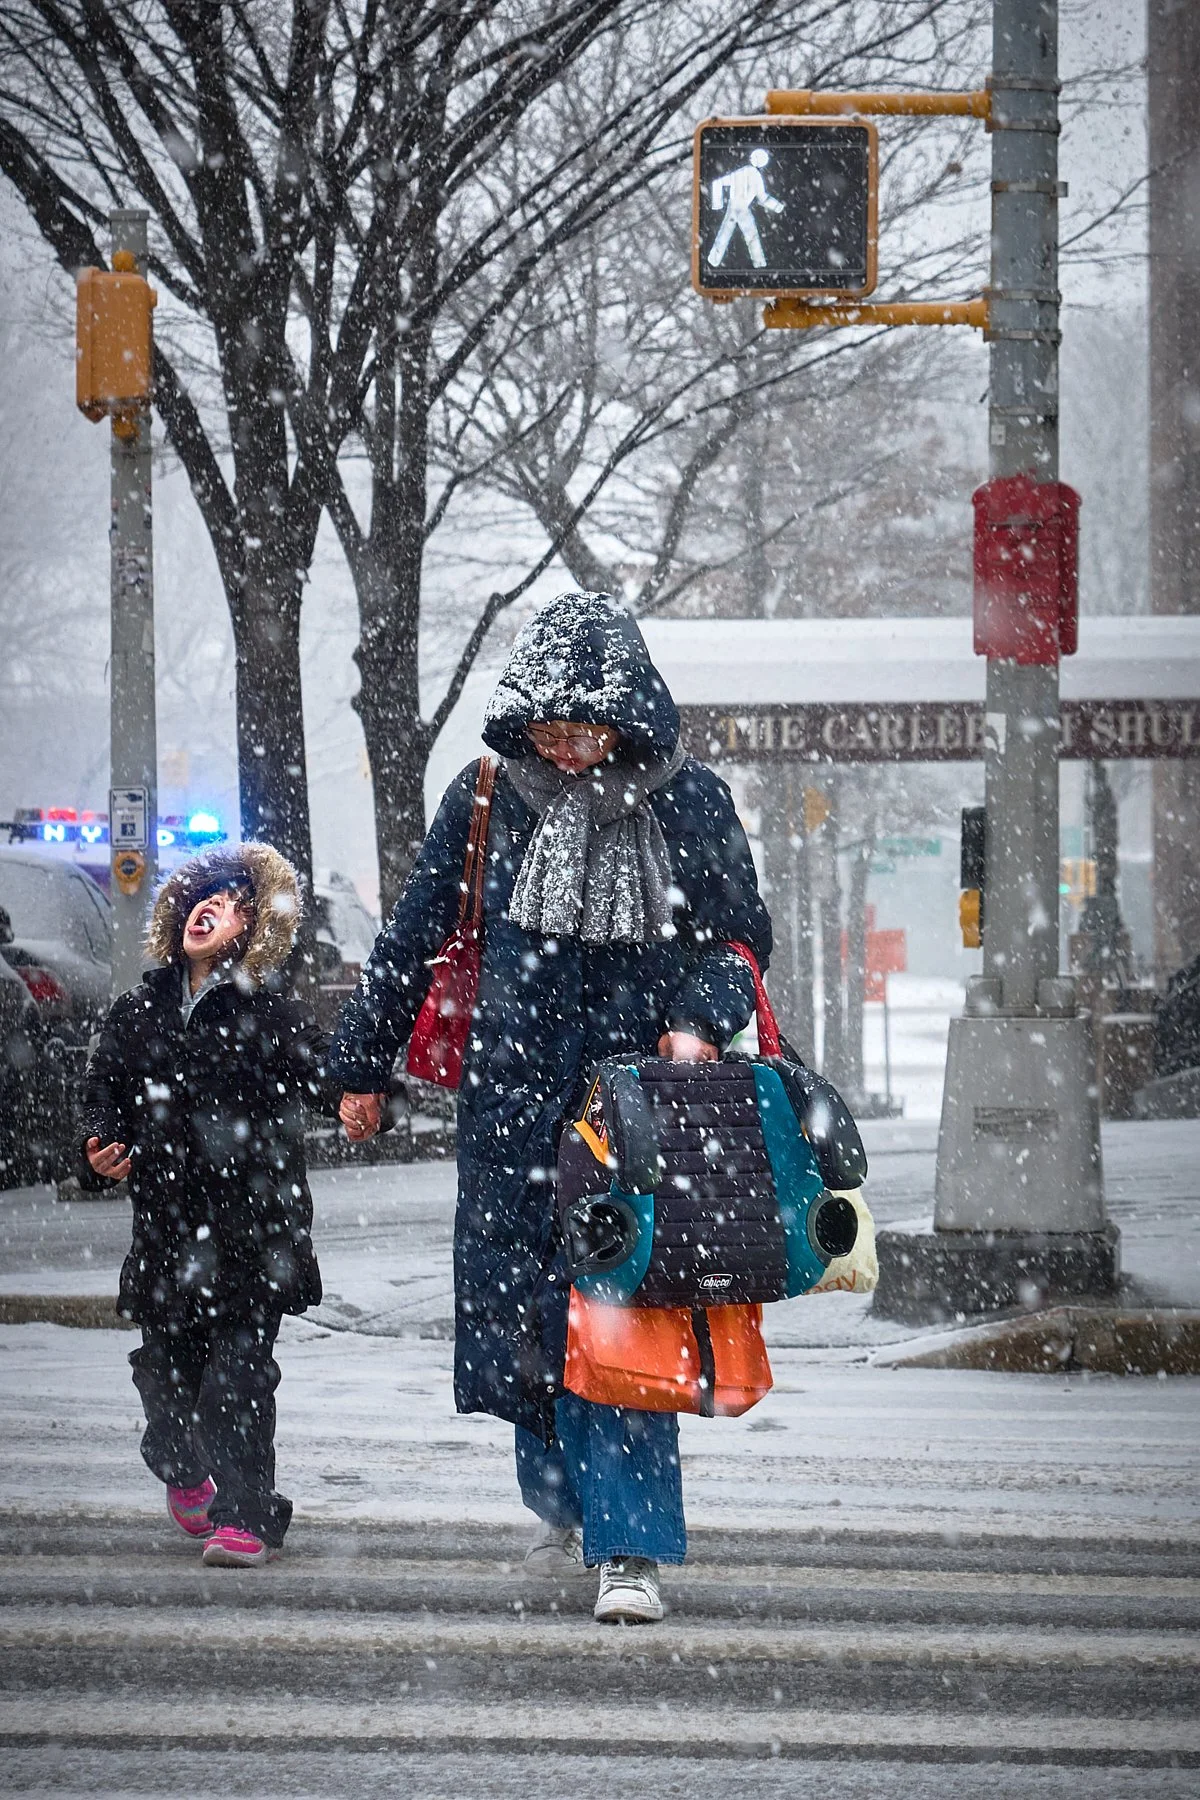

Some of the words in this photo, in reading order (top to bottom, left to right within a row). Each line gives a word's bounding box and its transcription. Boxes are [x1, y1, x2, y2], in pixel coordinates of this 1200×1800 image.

[719, 715, 806, 749] THE
[43, 823, 175, 847] NYD
[703, 1276, 730, 1288] chicco
